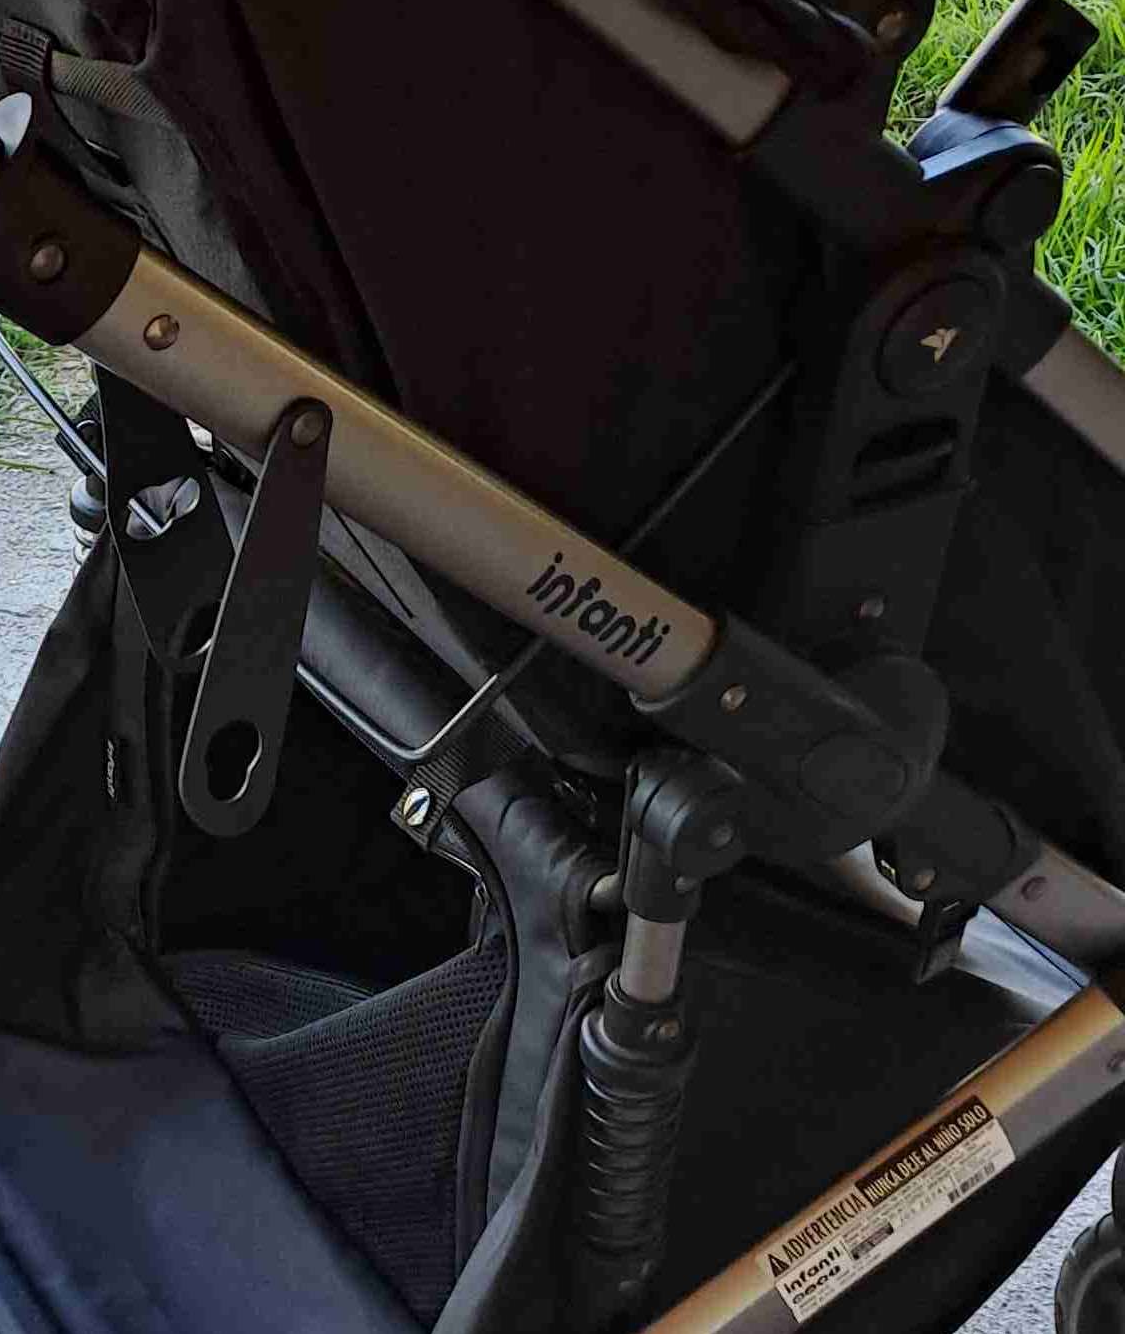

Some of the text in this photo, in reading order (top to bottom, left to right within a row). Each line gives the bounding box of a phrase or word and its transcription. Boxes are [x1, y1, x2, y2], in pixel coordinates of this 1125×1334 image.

[526, 552, 671, 665] infanti
[897, 1150, 925, 1177] DEJE
[923, 1142, 938, 1161] AL
[934, 1123, 962, 1152] NIÑO
[957, 1104, 987, 1133] SOLO
[782, 1193, 866, 1262] ADVERTENCIA
[784, 1247, 841, 1293] infanti
